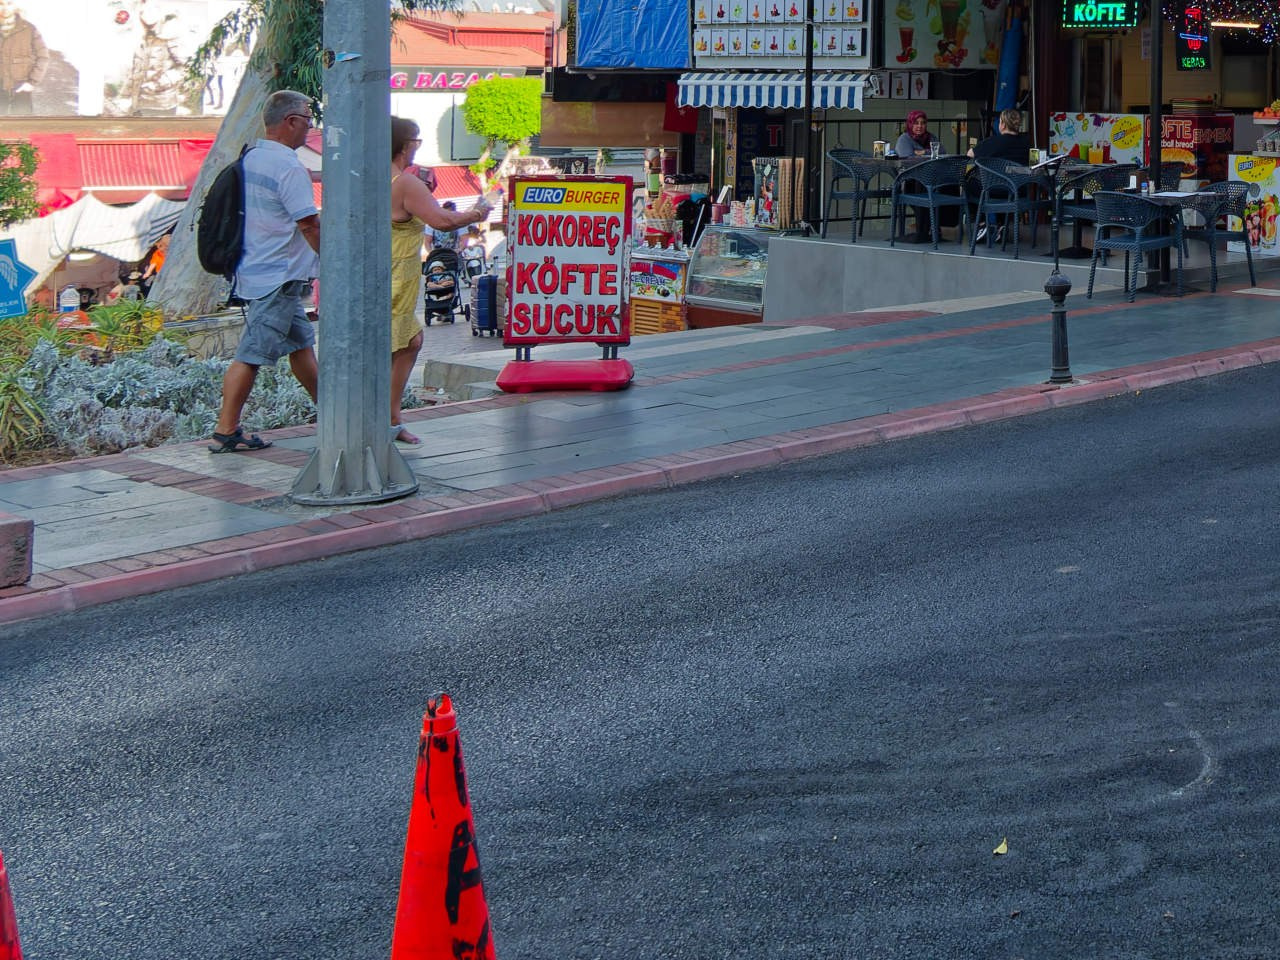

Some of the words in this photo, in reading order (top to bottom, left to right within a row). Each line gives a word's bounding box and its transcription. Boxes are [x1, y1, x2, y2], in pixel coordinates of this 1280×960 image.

[1074, 0, 1127, 22] KÖFTE
[524, 188, 564, 203] EURO
[565, 190, 620, 204] BURGER
[517, 214, 621, 255] KOKOREÇ
[515, 256, 618, 295] KÖFTE
[513, 303, 618, 335] SUCUK
